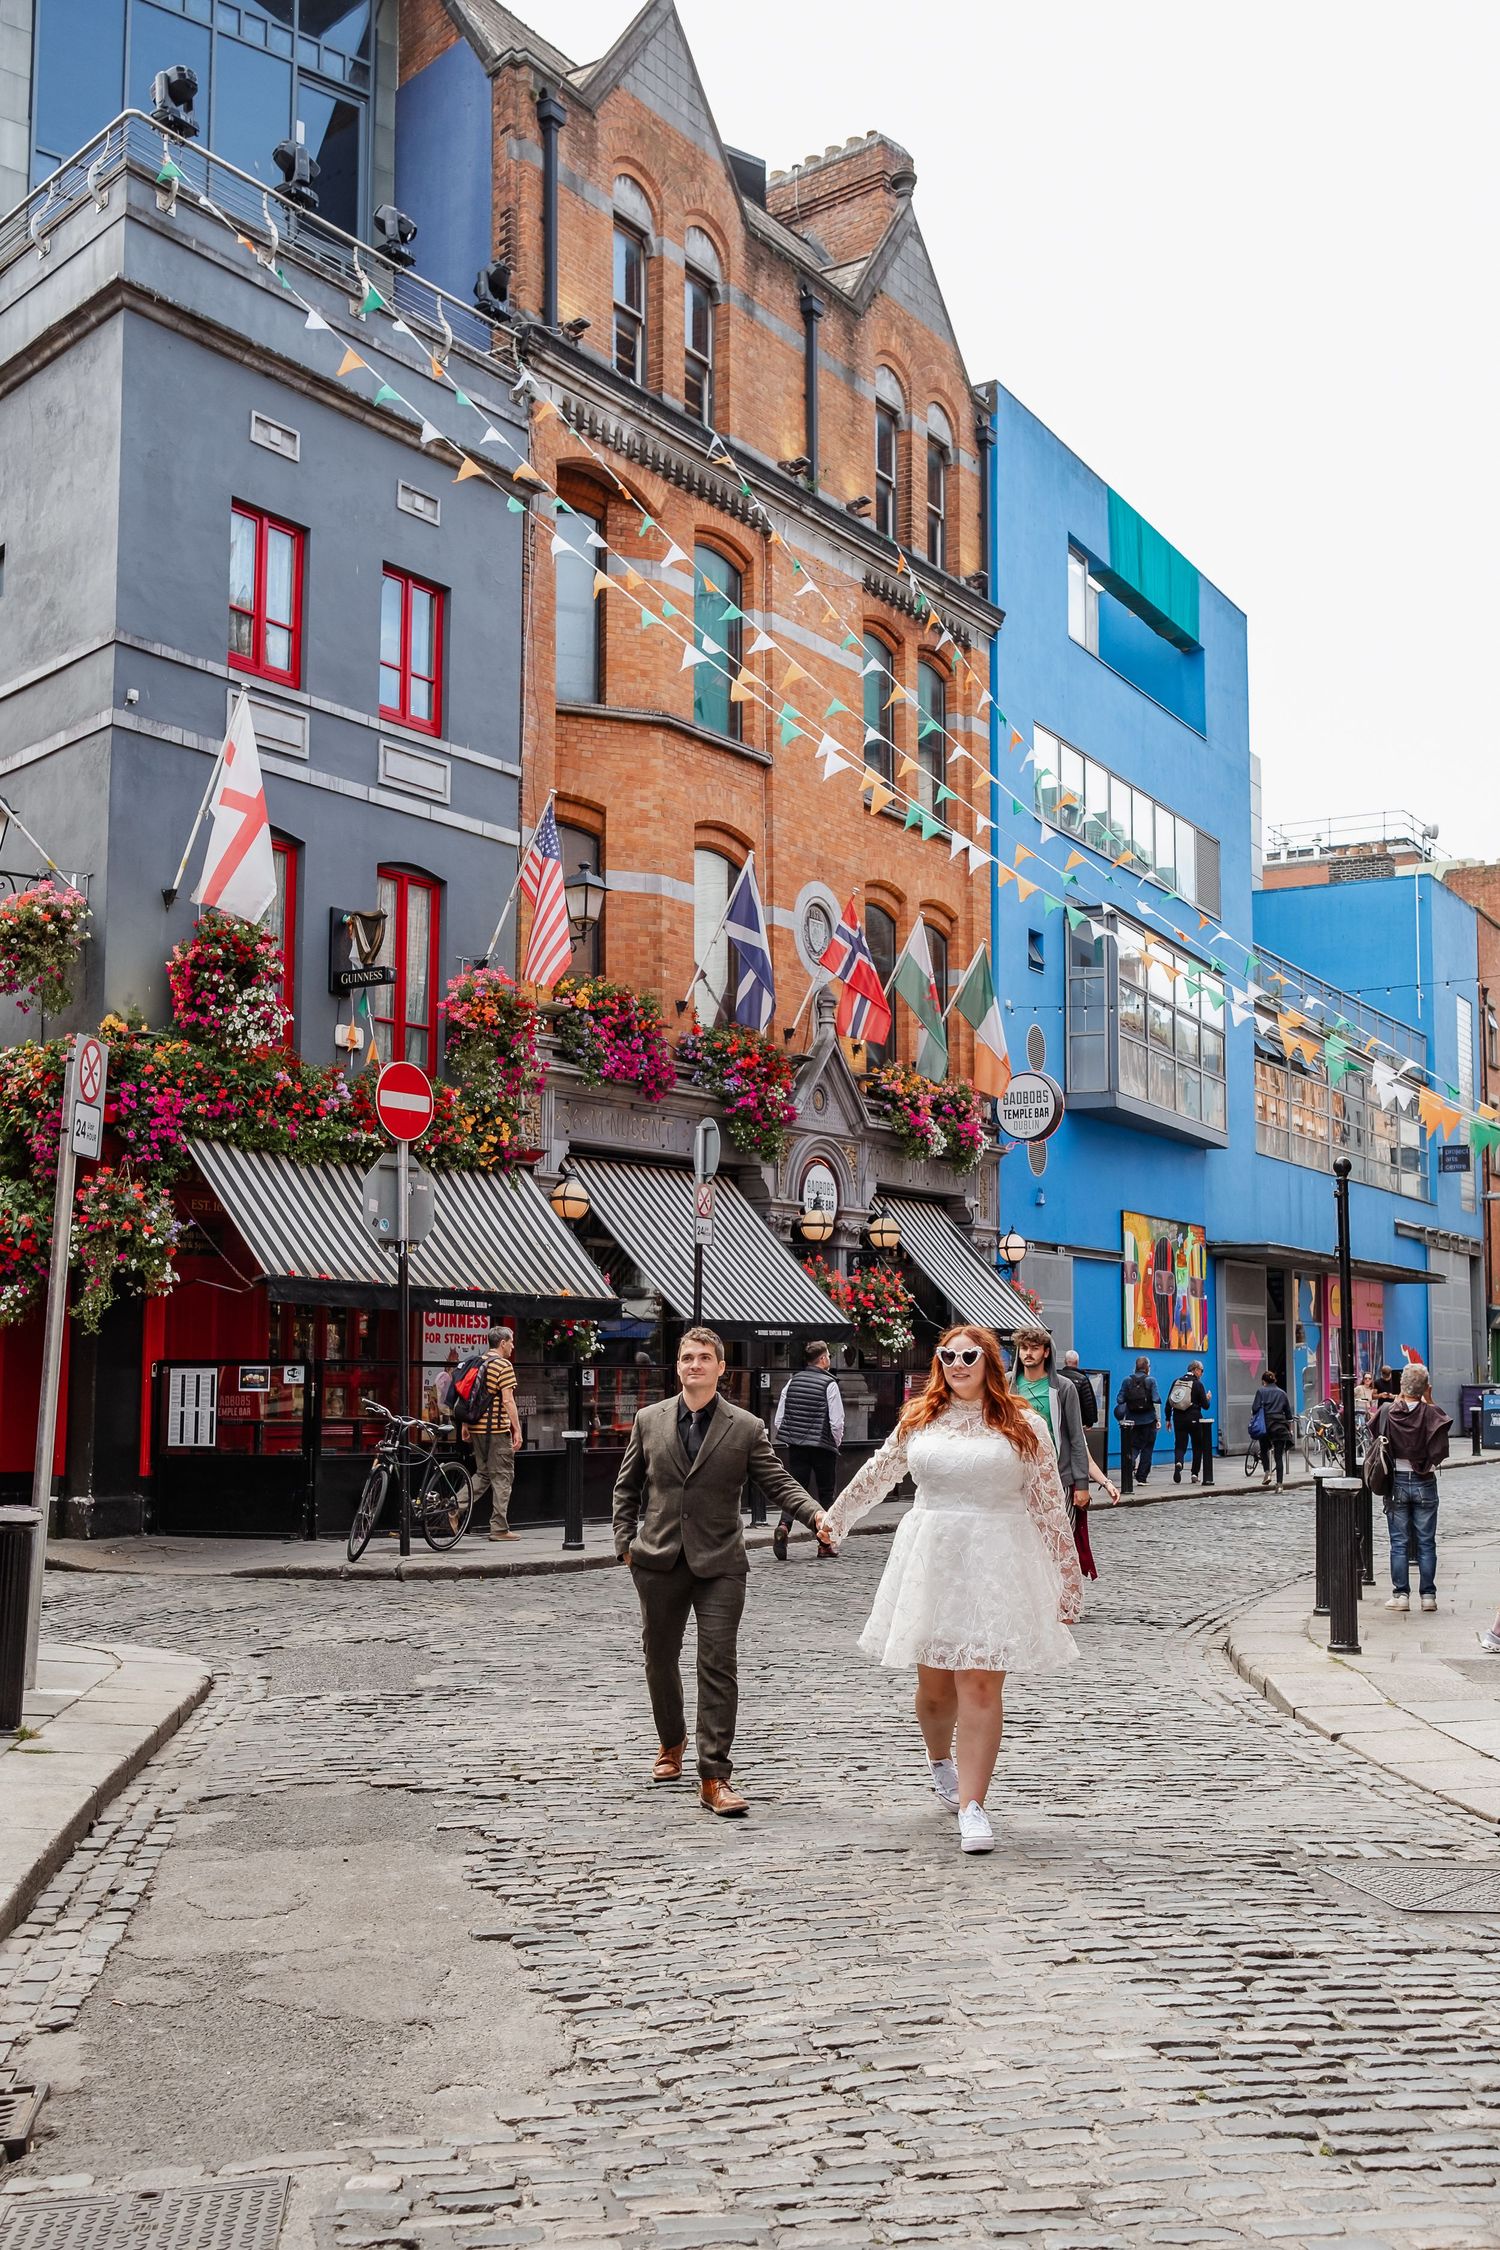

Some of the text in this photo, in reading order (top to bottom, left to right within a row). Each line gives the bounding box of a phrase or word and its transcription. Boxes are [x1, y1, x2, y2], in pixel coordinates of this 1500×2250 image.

[340, 969, 383, 985] GUINNESS
[1002, 1089, 1049, 1106] BADBOBS
[1003, 1106, 1050, 1120] TEMPLE BAR
[76, 1118, 86, 1138] 24
[609, 1111, 674, 1144] NUGENT
[1013, 1119, 1040, 1131] DUBLIN
[807, 1179, 835, 1197] BADBOBS
[825, 1200, 835, 1212] BAR
[424, 1312, 489, 1329] GUINNESS
[424, 1332, 488, 1345] FOR STRENGTH
[219, 1395, 251, 1407] ADBOBS
[217, 1407, 251, 1416] EMPLE BAR
